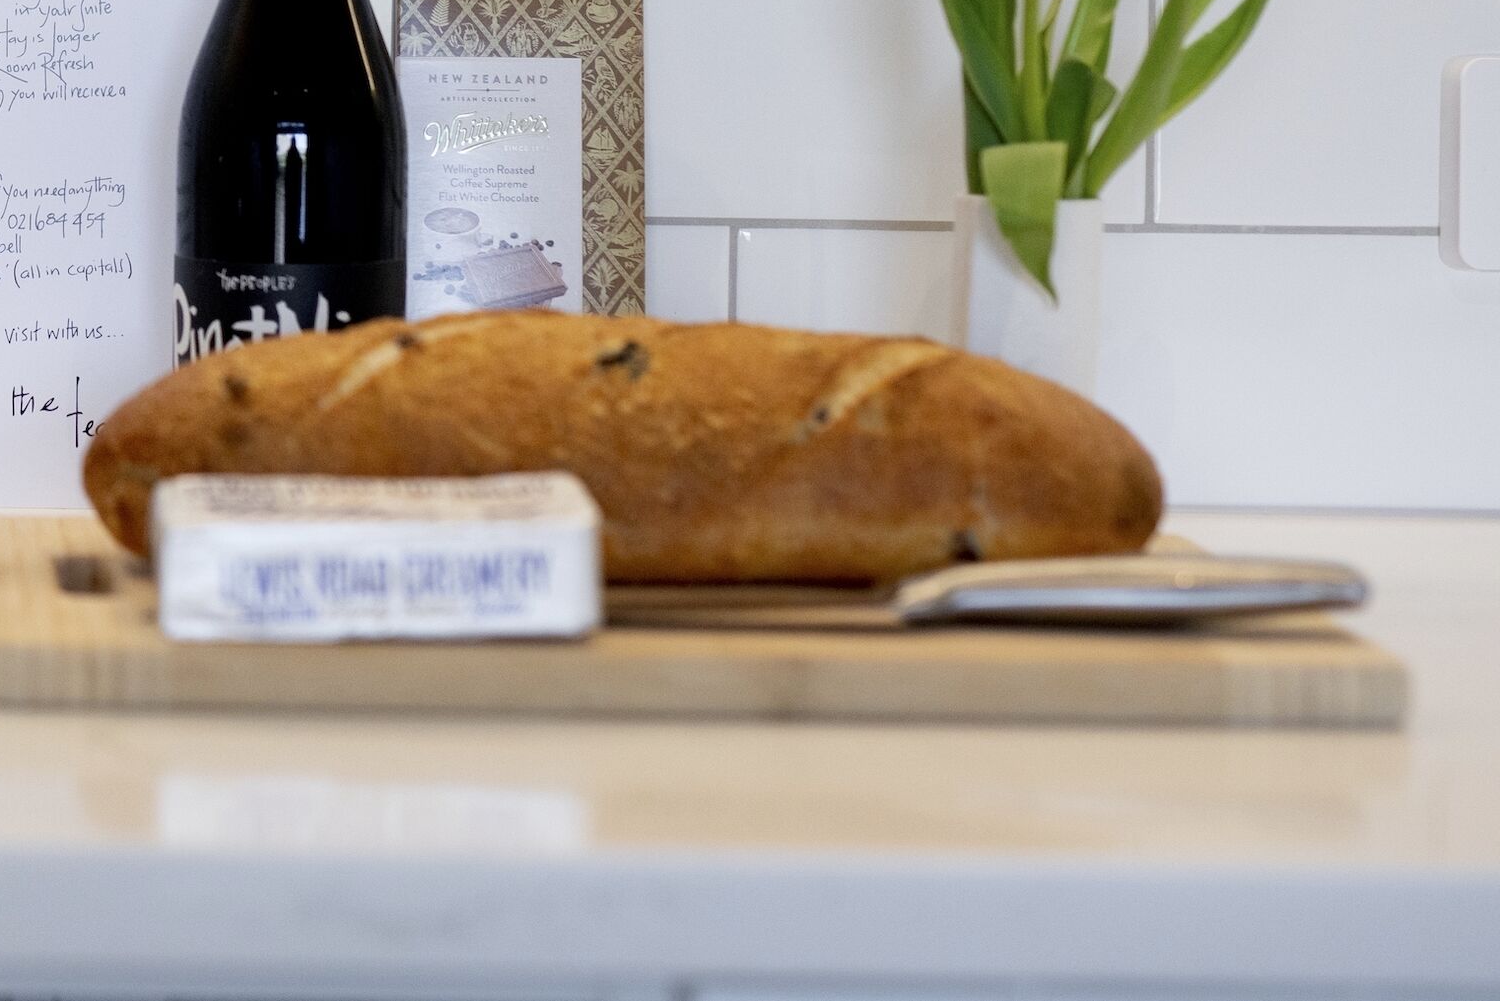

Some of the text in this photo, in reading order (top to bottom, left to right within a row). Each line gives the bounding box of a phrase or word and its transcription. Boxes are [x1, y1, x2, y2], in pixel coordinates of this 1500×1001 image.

[14, 2, 30, 16] in
[31, 33, 44, 43] is
[52, 21, 100, 58] longer
[37, 49, 94, 89] Refresh
[428, 74, 549, 85] NEW ZEALAND
[8, 88, 36, 112] you
[42, 84, 68, 101] will
[70, 85, 117, 99] recieve
[118, 86, 127, 97] a
[443, 164, 536, 178] Wellington Roasted
[0, 183, 29, 219] you
[33, 178, 67, 204] need
[68, 176, 125, 209] anything
[438, 192, 540, 204] Flat White Chocolate
[450, 178, 529, 192] Coffee Supreme
[13, 259, 41, 289] (all
[45, 264, 61, 277] in
[67, 252, 133, 282] capitals)
[46, 317, 79, 341] with
[11, 385, 60, 417] the
